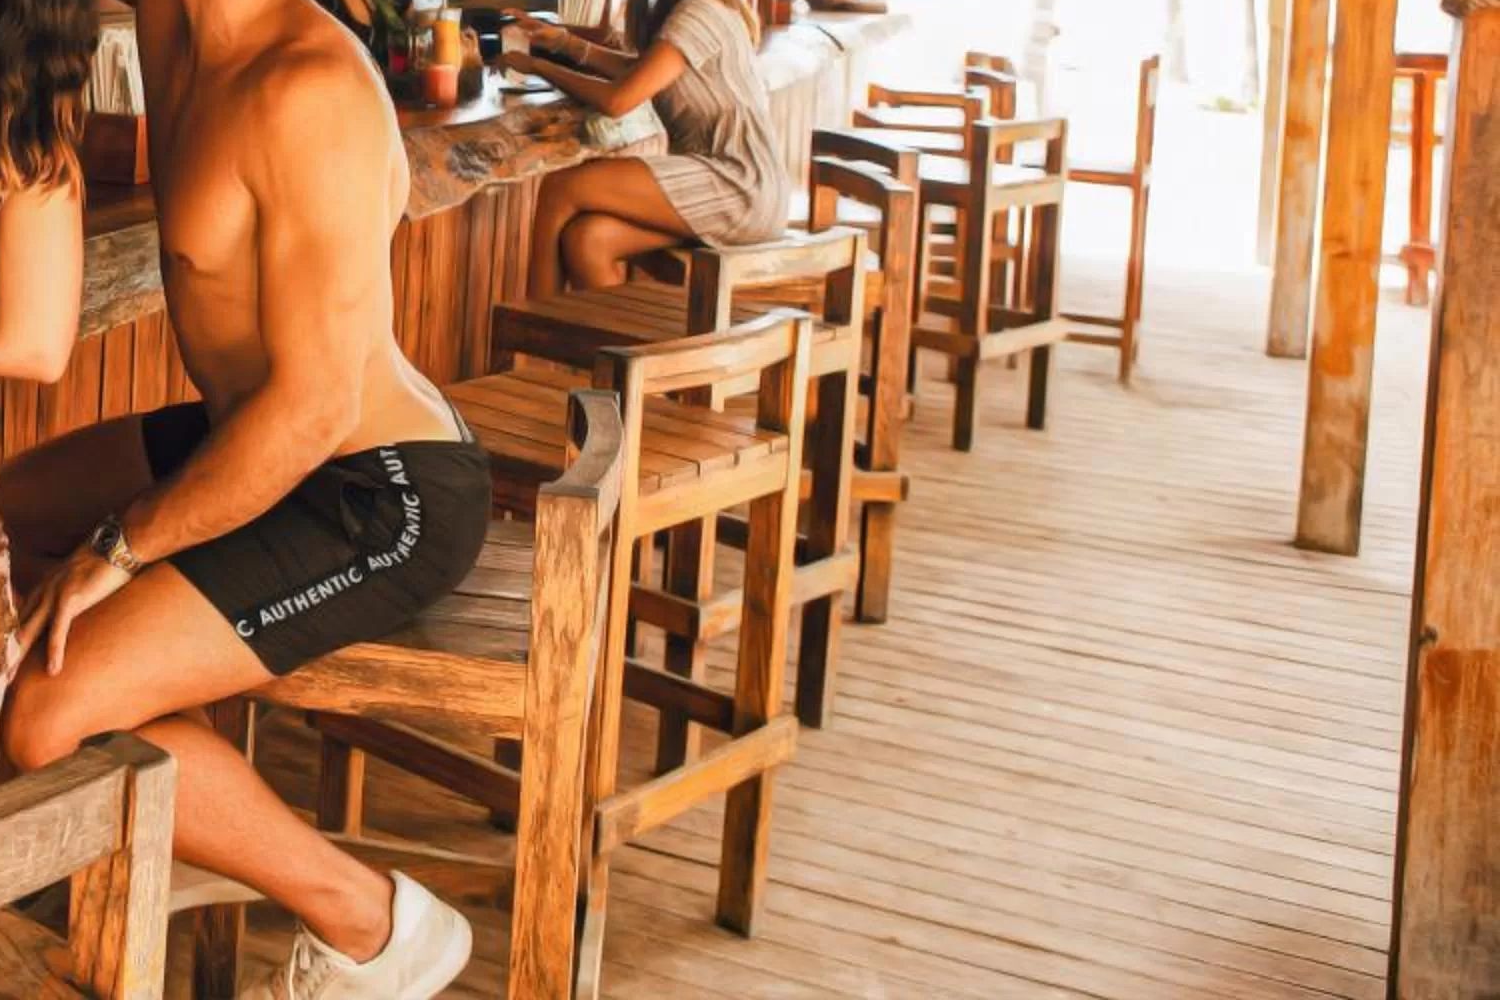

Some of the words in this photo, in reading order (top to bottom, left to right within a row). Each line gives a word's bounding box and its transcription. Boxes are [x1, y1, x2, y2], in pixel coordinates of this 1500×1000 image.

[235, 619, 255, 637] C
[259, 566, 363, 627] AUTHENTIC
[366, 492, 422, 572] AUTHENTIC
